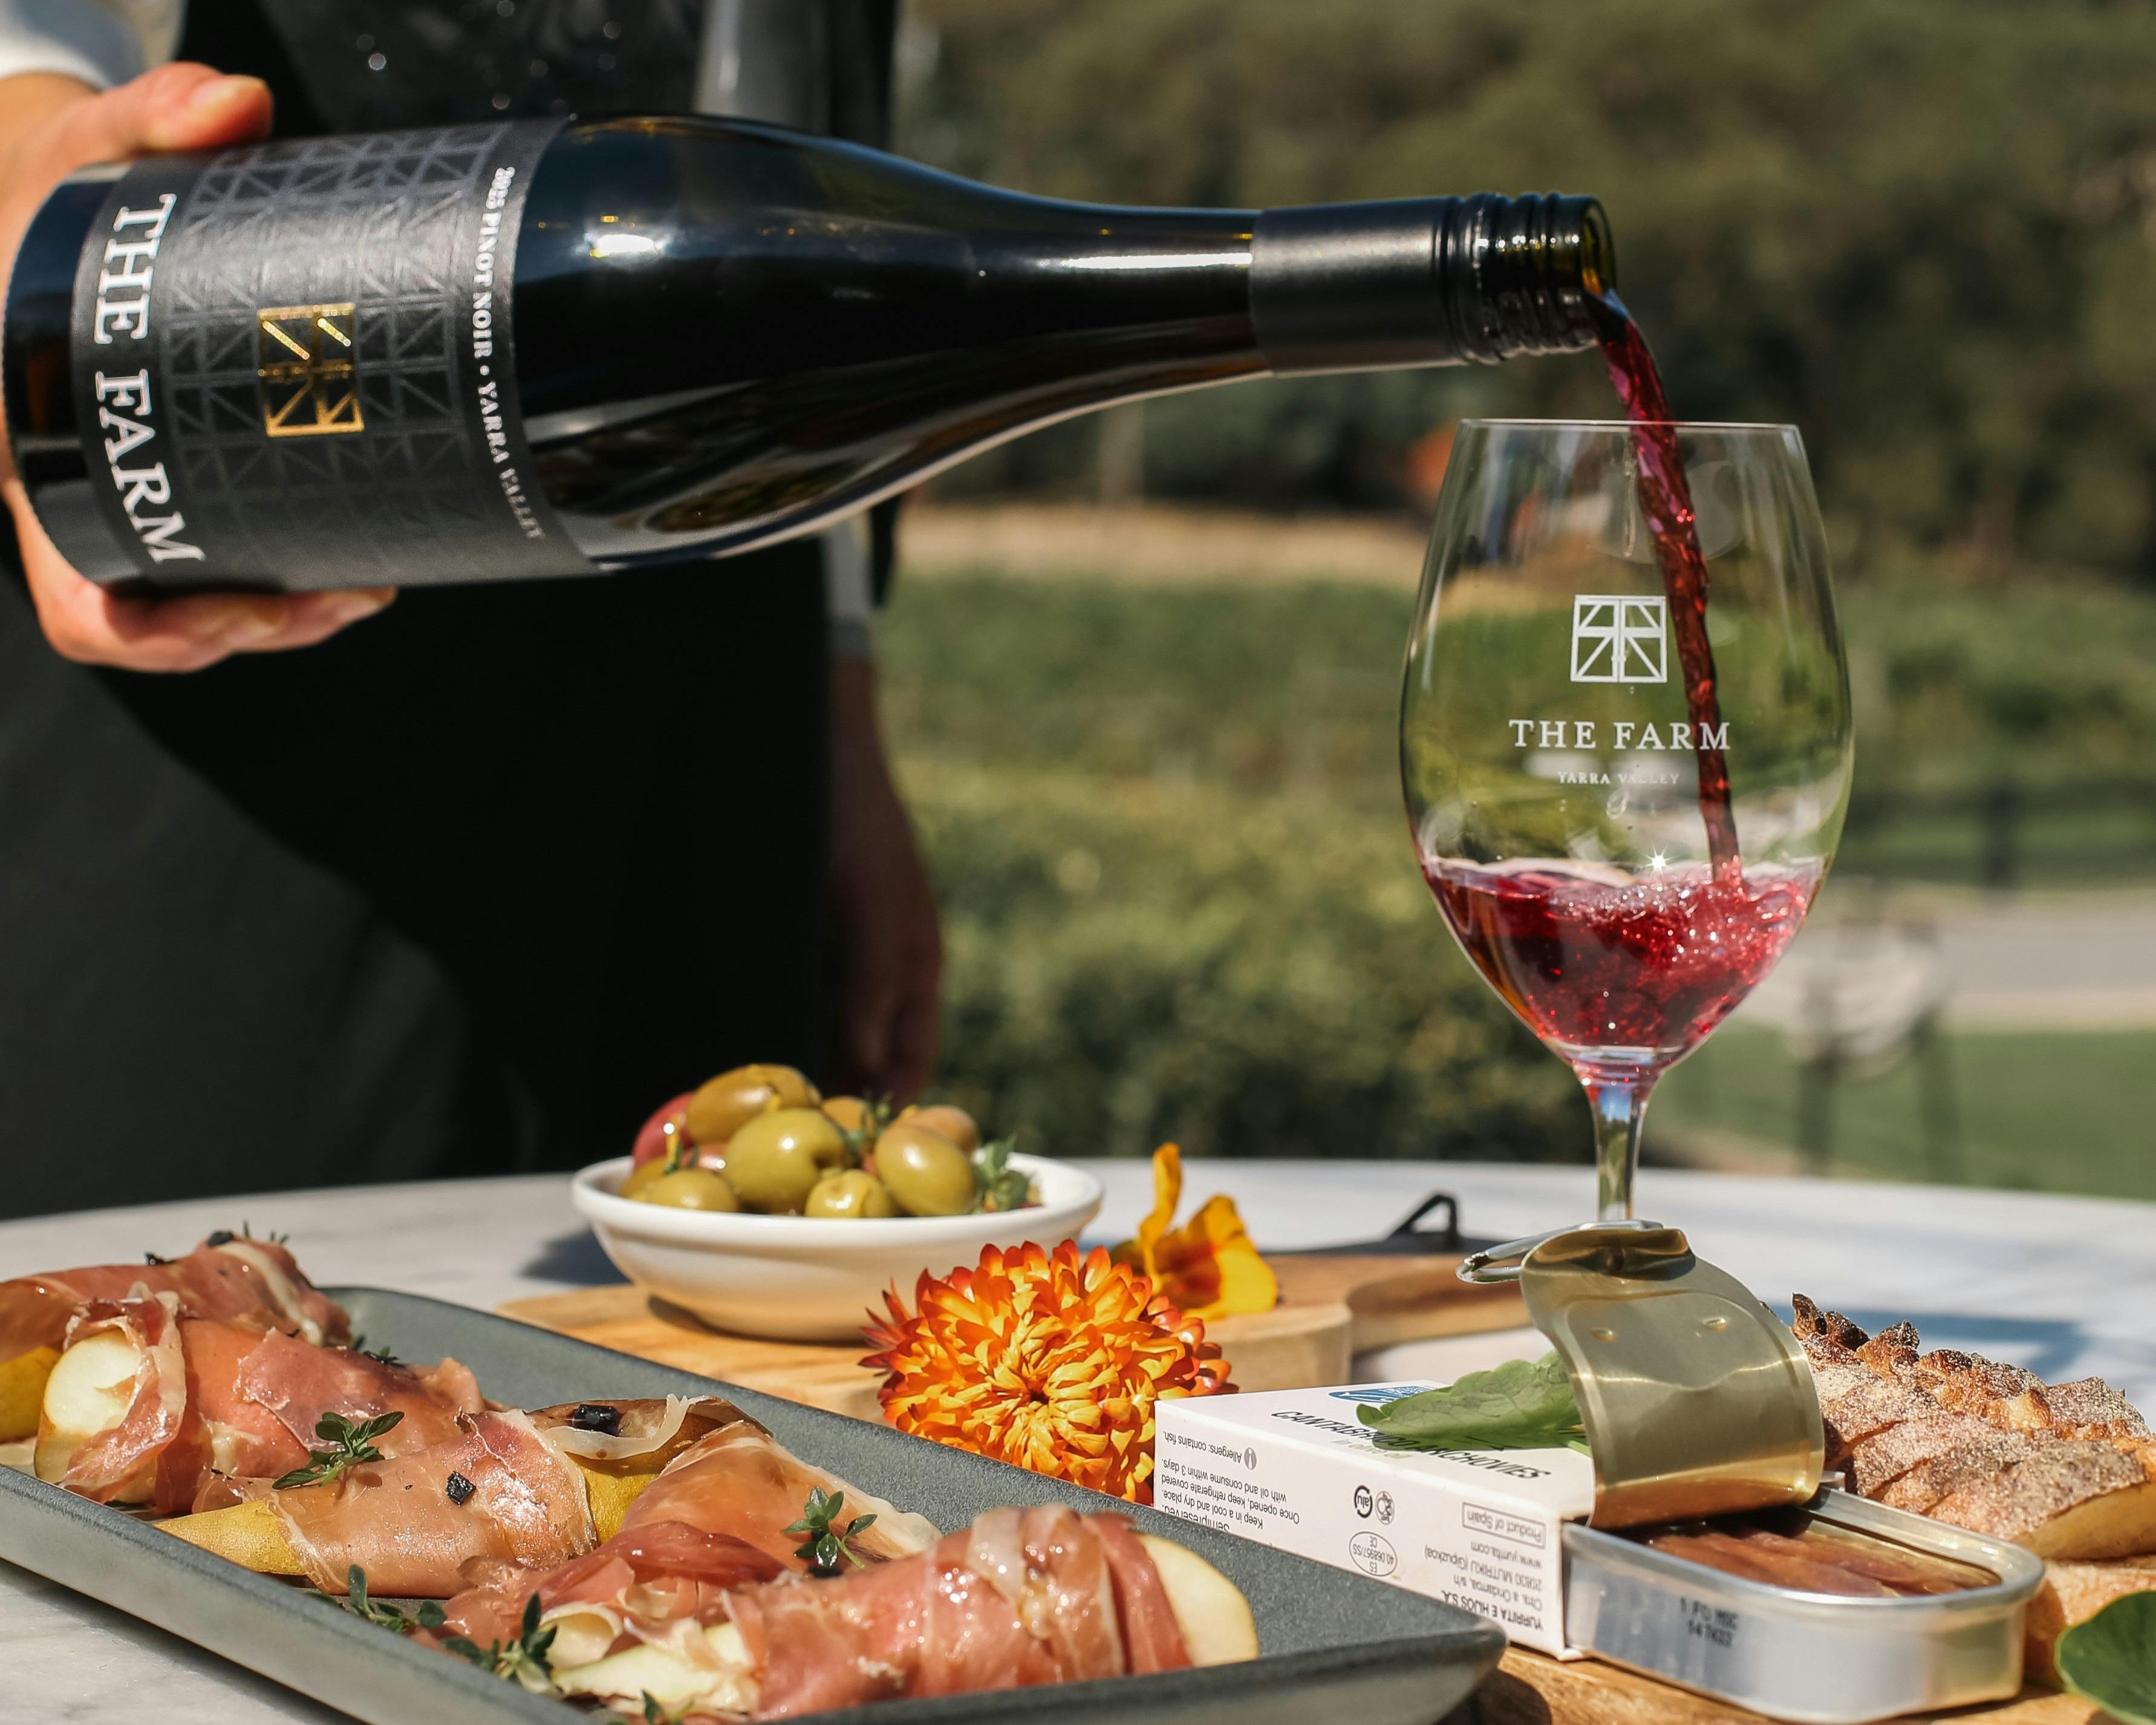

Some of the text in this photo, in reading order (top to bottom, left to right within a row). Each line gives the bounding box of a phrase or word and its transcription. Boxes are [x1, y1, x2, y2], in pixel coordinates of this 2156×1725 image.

[474, 212, 501, 287] PINOT
[472, 292, 493, 359] NOIR
[94, 194, 206, 562] THE FARM
[478, 380, 509, 464] YARRA
[499, 468, 546, 538] VALLEY
[1509, 719, 1731, 751] THE FARM
[1557, 771, 1679, 785] YARRA VALLEY
[1162, 1431, 1242, 1464] Allergens: contains fish.
[1404, 1444, 1551, 1479] ANCHOVIES
[1162, 1458, 1287, 1503] with oil and consume within 3 days.
[1162, 1474, 1300, 1524] Once opened, keep refrigerate covered
[1162, 1489, 1263, 1530] Keep in a cool and dry place.
[1357, 1495, 1370, 1508] alu
[1369, 1535, 1378, 1548] CE
[1467, 1510, 1543, 1543] Product of Spain
[1369, 1561, 1378, 1573] ES
[1492, 1605, 1497, 1617] E
